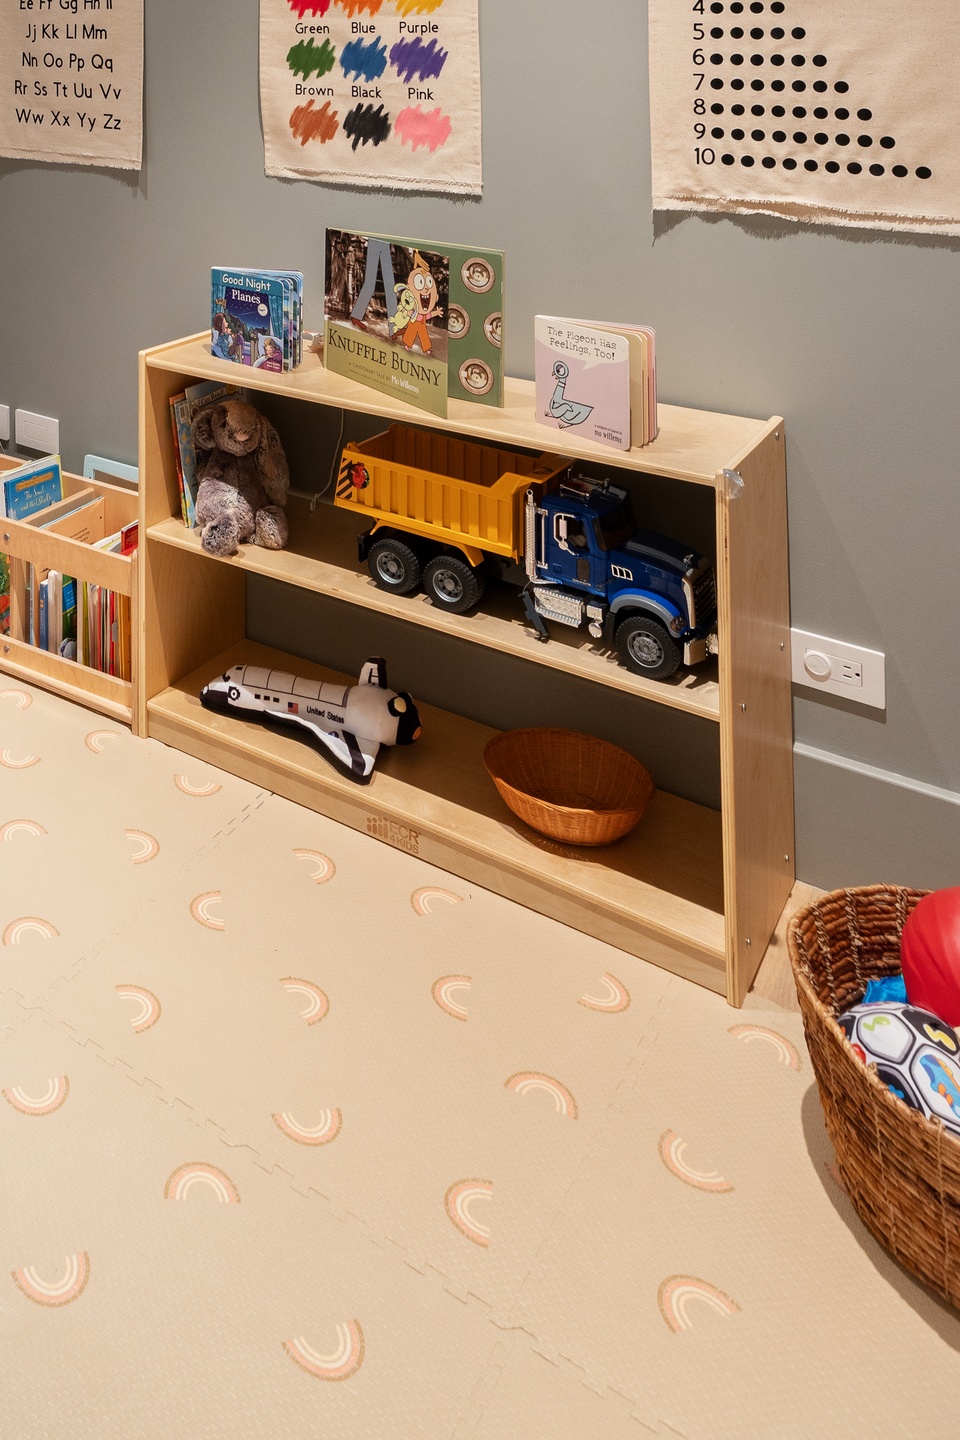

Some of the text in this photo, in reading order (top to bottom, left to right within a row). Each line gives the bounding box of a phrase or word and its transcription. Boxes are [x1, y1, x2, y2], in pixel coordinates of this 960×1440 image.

[25, 24, 37, 42] Jj
[41, 24, 60, 38] Kk
[82, 24, 108, 39] Mm
[294, 21, 439, 35] Green Blue Purple
[692, 24, 705, 40] 5
[21, 52, 114, 72] Nn Oo Pp Qq
[692, 49, 705, 65] 6
[14, 80, 122, 99] Rr Ss Tt Uu Vv
[692, 74, 705, 90] 7
[295, 84, 434, 100] Brown Black Pink
[693, 99, 707, 115] 8
[15, 108, 122, 132] Ww Xx Yy Zz
[693, 123, 706, 139] 9
[694, 148, 716, 164] 10
[222, 273, 271, 292] Good Night
[231, 288, 261, 305] Planes
[547, 326, 617, 350] The Pigeon Has
[328, 328, 388, 366] KNUFFLE
[391, 350, 442, 387] BUNNY
[549, 337, 616, 361] Feelings, Too!
[391, 375, 400, 386] Mo
[306, 705, 345, 724] United States
[390, 820, 419, 845] ECR
